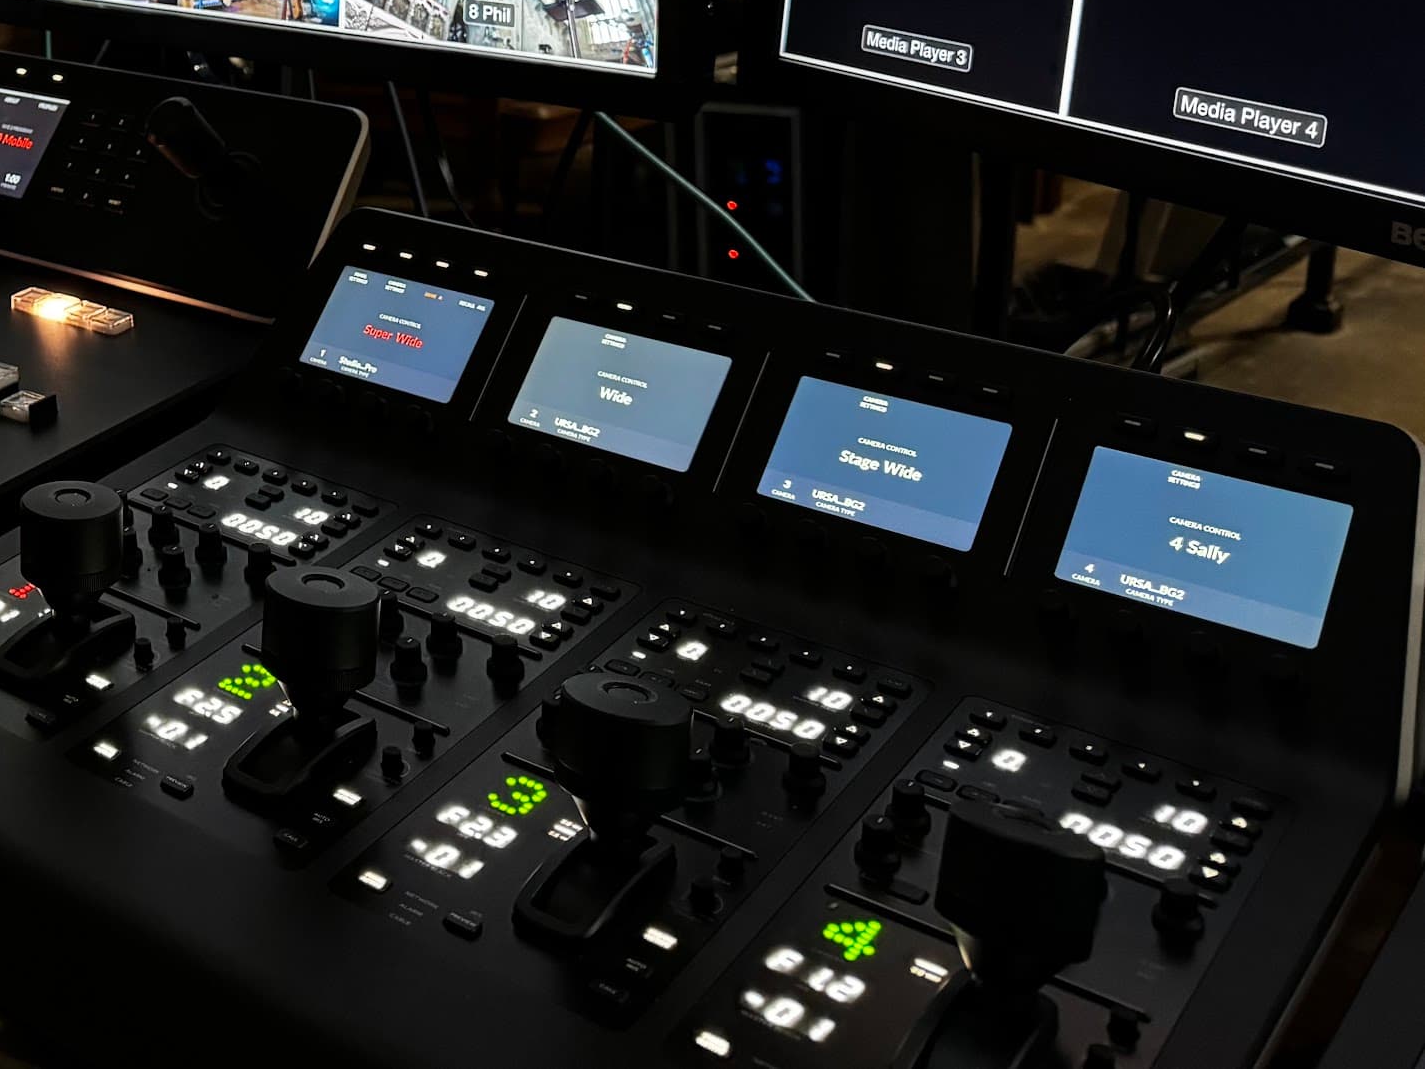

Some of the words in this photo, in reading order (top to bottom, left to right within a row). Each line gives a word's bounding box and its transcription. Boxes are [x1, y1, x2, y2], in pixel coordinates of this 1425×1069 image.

[468, 3, 478, 19] 8
[481, 4, 512, 24] Phil
[866, 30, 909, 54] Media
[910, 39, 955, 63] Player
[955, 49, 968, 66] 3
[1180, 94, 1236, 123] Media
[1240, 106, 1302, 136] Player
[1304, 121, 1319, 140] 4
[2, 133, 33, 150] Mobile
[362, 324, 393, 342] Super
[395, 332, 424, 350] Wide
[597, 370, 621, 383] CAMERA
[599, 386, 633, 406] Wide
[529, 408, 539, 418] 2
[857, 436, 885, 450] CAMERA
[885, 443, 918, 458] CONTROL
[838, 449, 880, 472] Stage
[883, 460, 923, 482] Wide
[1171, 469, 1201, 482] CAMERA
[782, 479, 792, 489] 3
[815, 501, 840, 514] CAMERA
[221, 512, 299, 546] 0050
[1168, 516, 1202, 532] CAMERA
[1203, 523, 1242, 541] CONTROL
[1168, 536, 1184, 552] 4
[1185, 539, 1231, 565] Sally
[1071, 573, 1101, 587] CAMERA
[1084, 562, 1095, 574] 4
[1119, 573, 1186, 601] URSA_BG2
[1125, 588, 1155, 602] CAMERA
[1155, 595, 1174, 607] TYPE
[446, 596, 536, 635] 0050
[217, 663, 277, 700] 2
[720, 693, 826, 740] 0050
[487, 775, 548, 816] 3
[823, 920, 882, 962] 4
